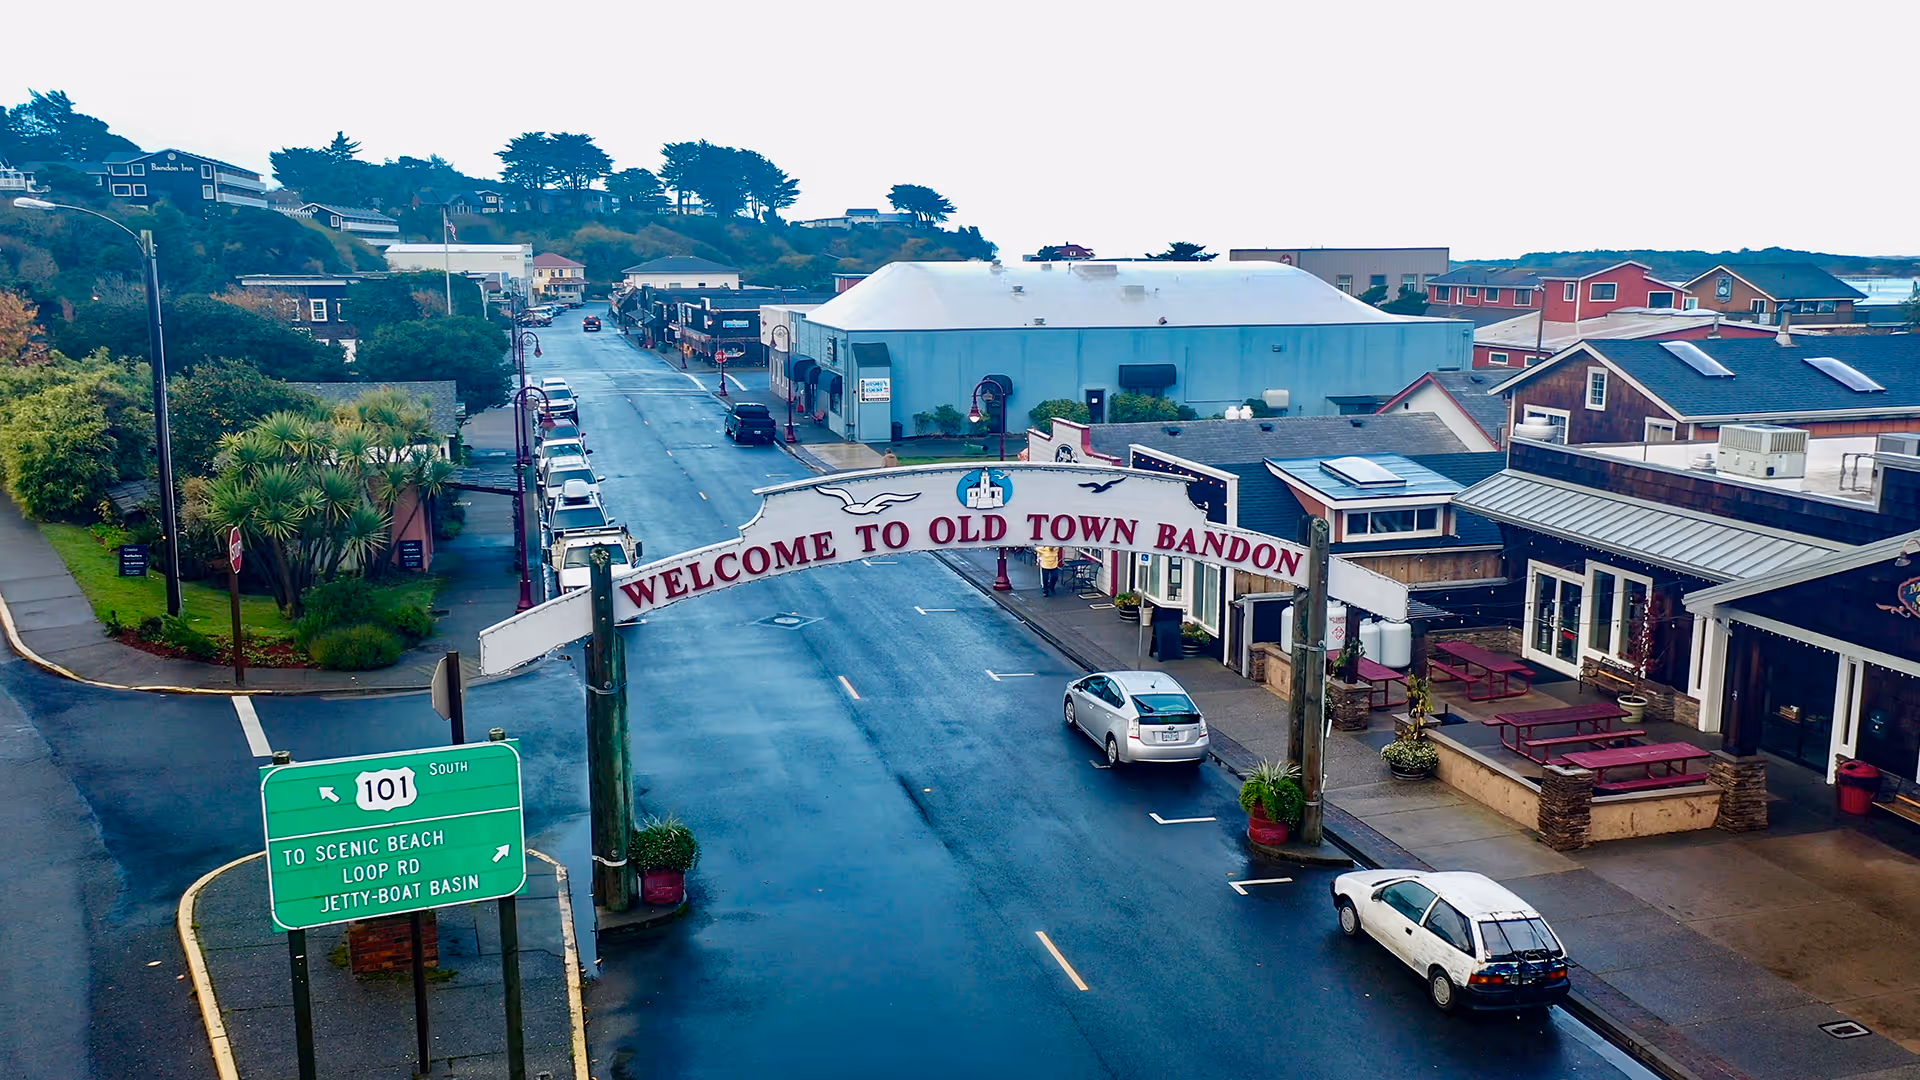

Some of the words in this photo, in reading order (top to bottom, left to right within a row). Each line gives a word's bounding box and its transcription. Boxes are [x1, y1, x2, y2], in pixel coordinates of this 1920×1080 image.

[151, 163, 178, 171] Bandon
[181, 163, 194, 172] Inn
[620, 531, 836, 608] WELCOME
[855, 521, 910, 552] TO
[928, 515, 1007, 545] OLD
[1027, 514, 1139, 544] TOWN
[1156, 523, 1304, 577] BANDON
[364, 776, 407, 803] 101
[283, 848, 305, 866] TO
[315, 838, 380, 862] SCENIC
[388, 830, 444, 853] BEACH
[343, 863, 389, 884] LOOP
[397, 858, 421, 876] RD
[320, 882, 421, 913] JETTY-BOAT
[430, 874, 480, 897] BASIN
